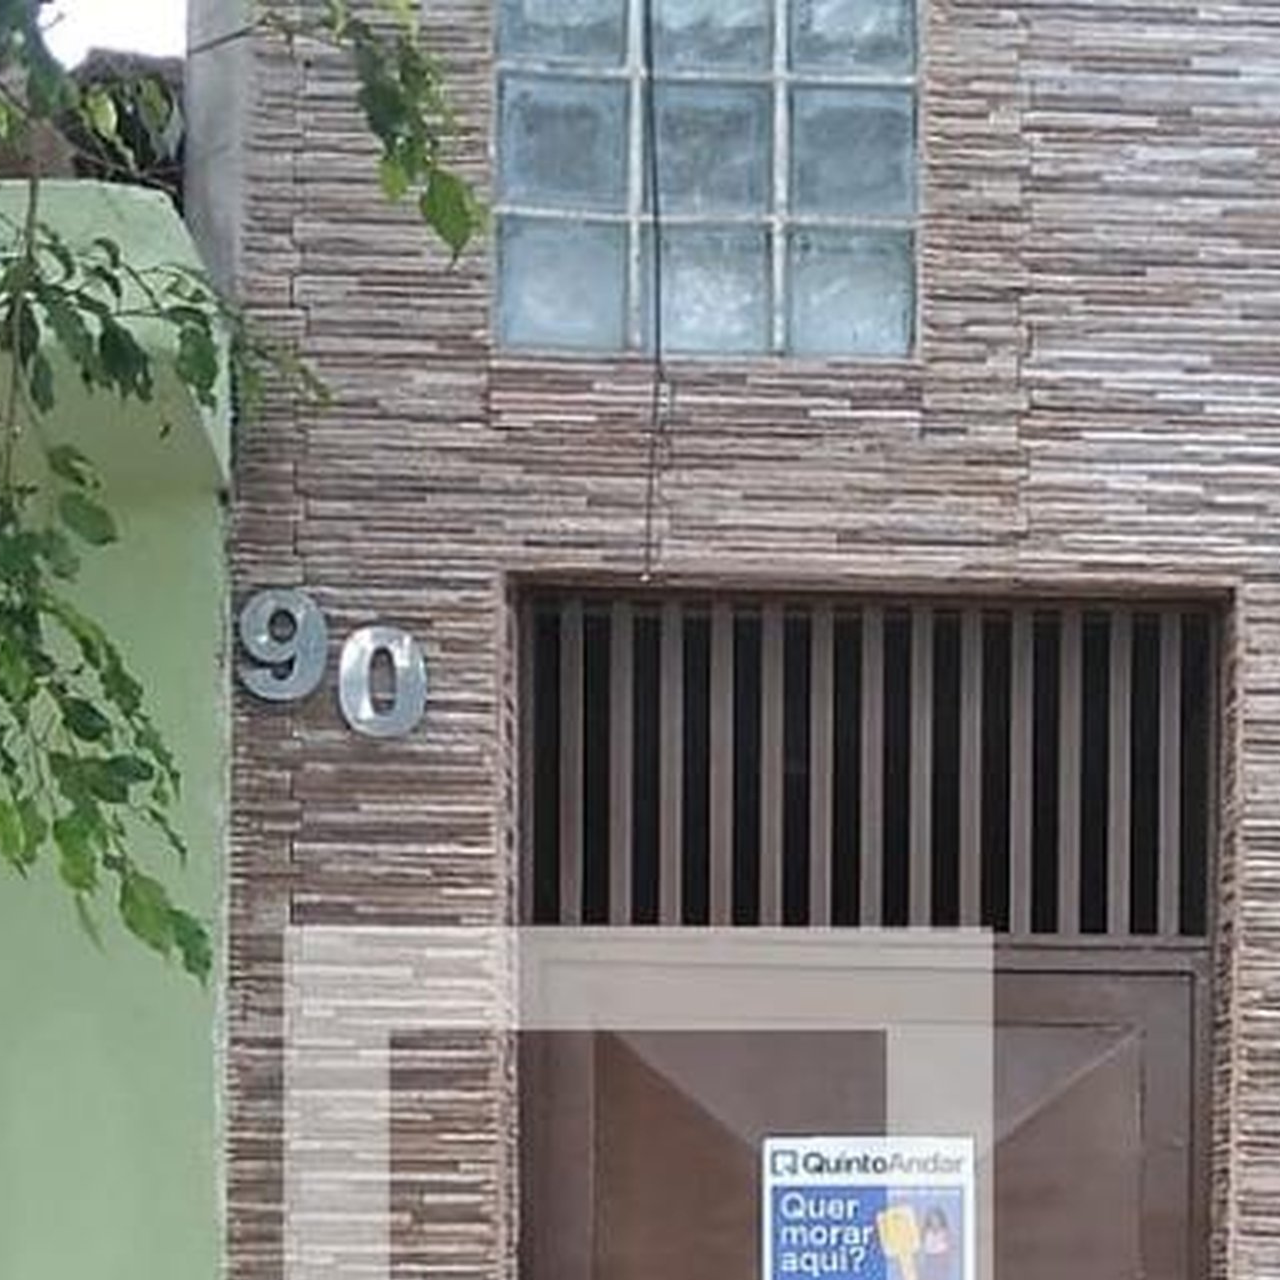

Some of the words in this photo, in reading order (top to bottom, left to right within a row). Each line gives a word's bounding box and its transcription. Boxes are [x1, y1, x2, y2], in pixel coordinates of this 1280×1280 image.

[238, 587, 428, 738] 90
[802, 1150, 964, 1175] QuintoAndar
[780, 1192, 860, 1219] Quer
[780, 1224, 873, 1246] morar
[780, 1246, 867, 1277] aqui?
